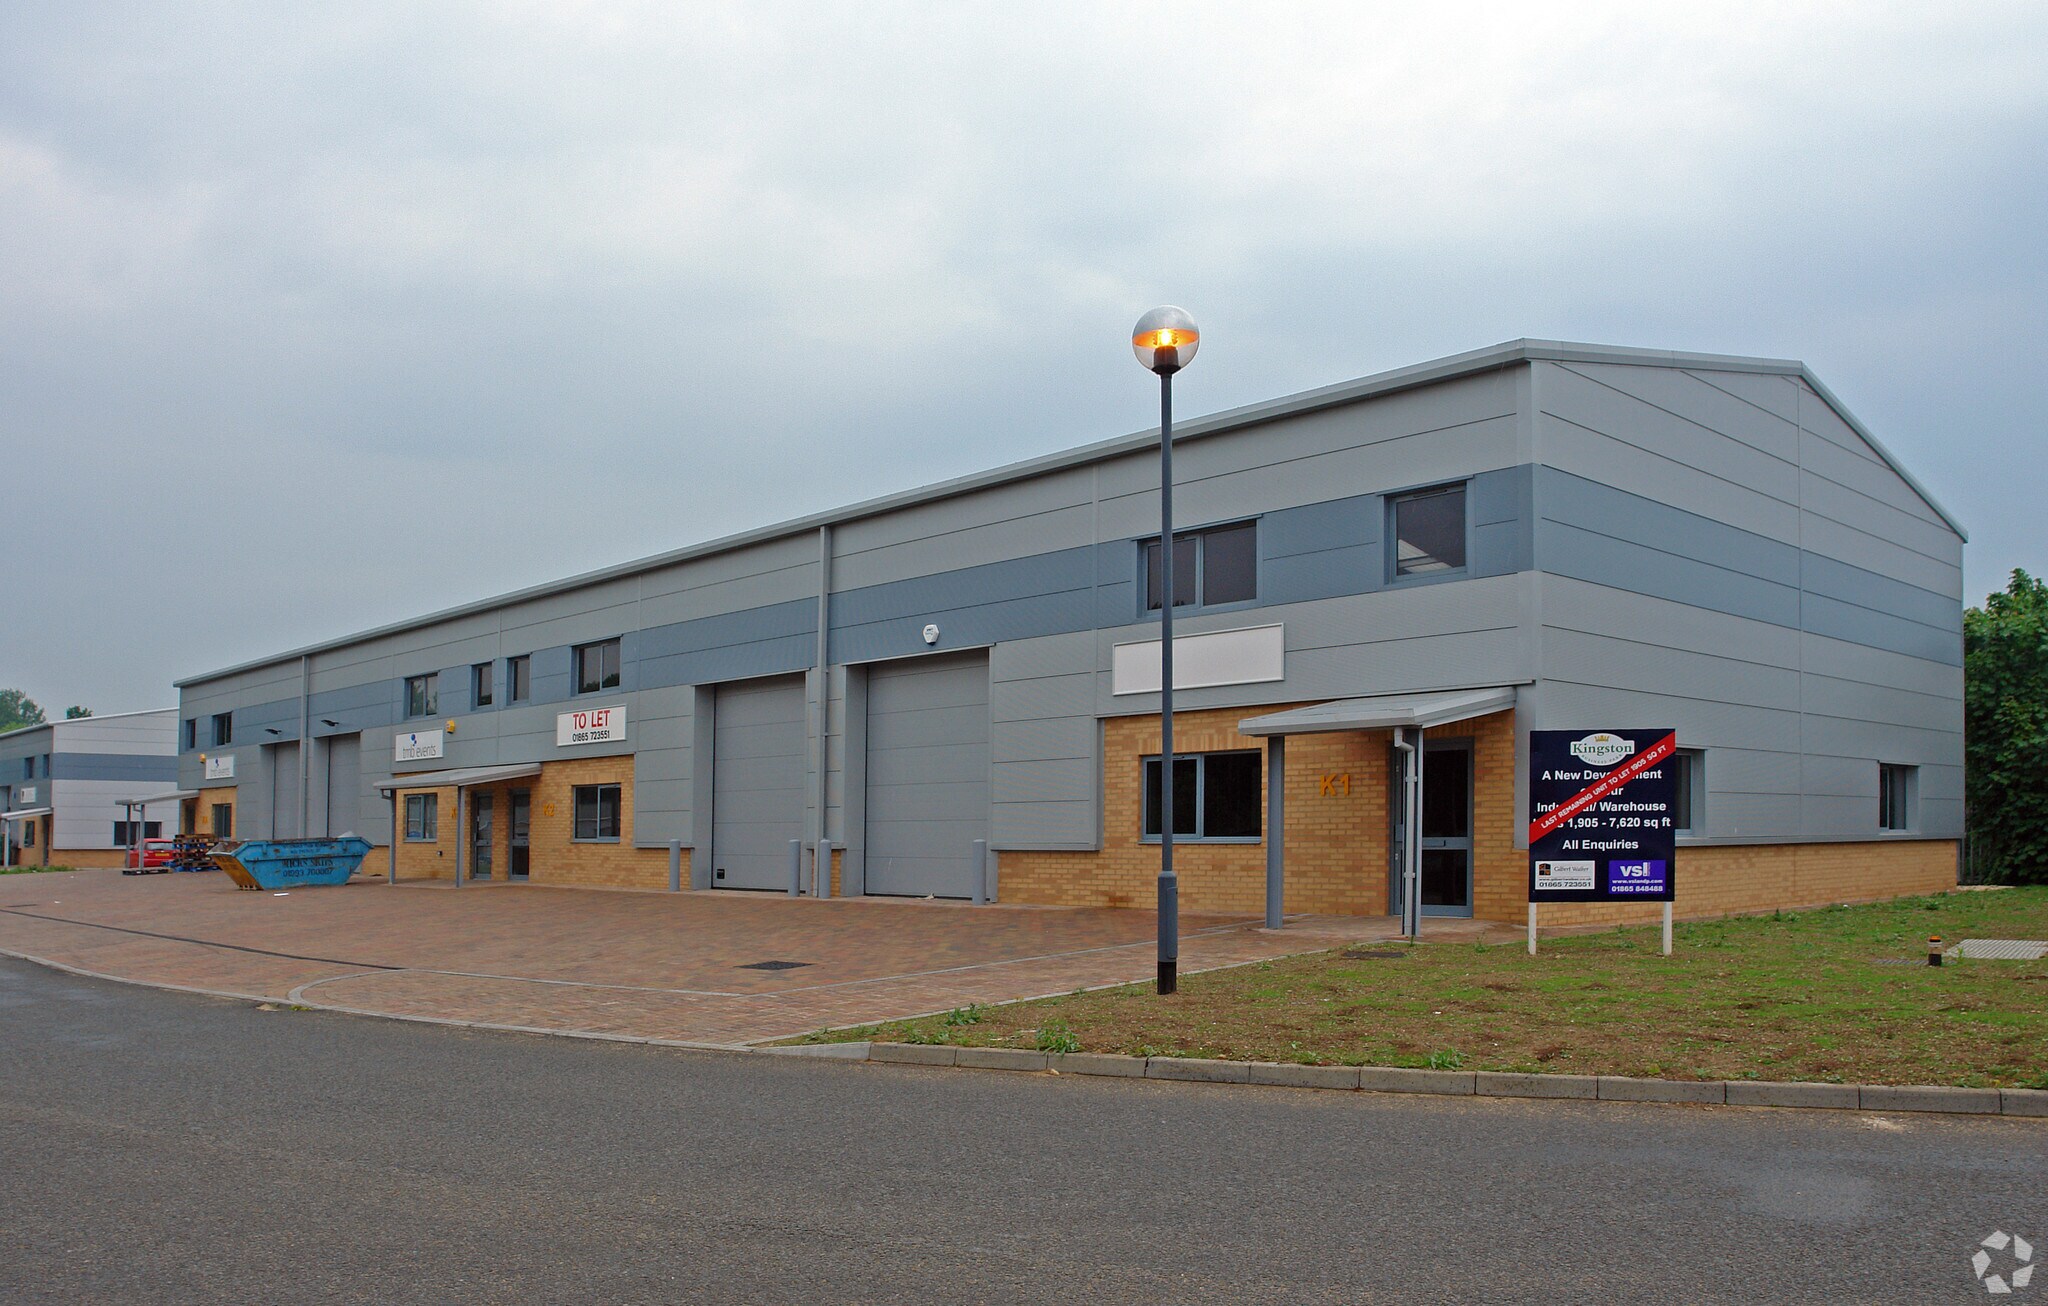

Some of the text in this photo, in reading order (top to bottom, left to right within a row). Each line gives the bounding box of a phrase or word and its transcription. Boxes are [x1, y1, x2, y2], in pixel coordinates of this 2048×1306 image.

[573, 710, 611, 730] TO LET
[572, 730, 610, 742] 01865 723551
[1572, 743, 1632, 756] Kingston
[1542, 770, 1551, 780] A
[1554, 770, 1581, 780] New
[1319, 772, 1350, 797] K1
[1541, 815, 1558, 829] LAST
[1558, 793, 1593, 818] REMAINING
[1592, 782, 1608, 795] UNIT
[1608, 776, 1618, 785] TO
[1618, 768, 1630, 779] LET
[1646, 751, 1658, 761] SQ
[1657, 744, 1667, 754] FT
[543, 803, 555, 817] K2
[1599, 801, 1667, 812] Warehouse
[1567, 818, 1599, 829] 1,905
[1609, 817, 1641, 829] 7,620
[1643, 819, 1658, 829] sq
[1661, 817, 1671, 827] ft
[1562, 839, 1639, 851] All Enquiries
